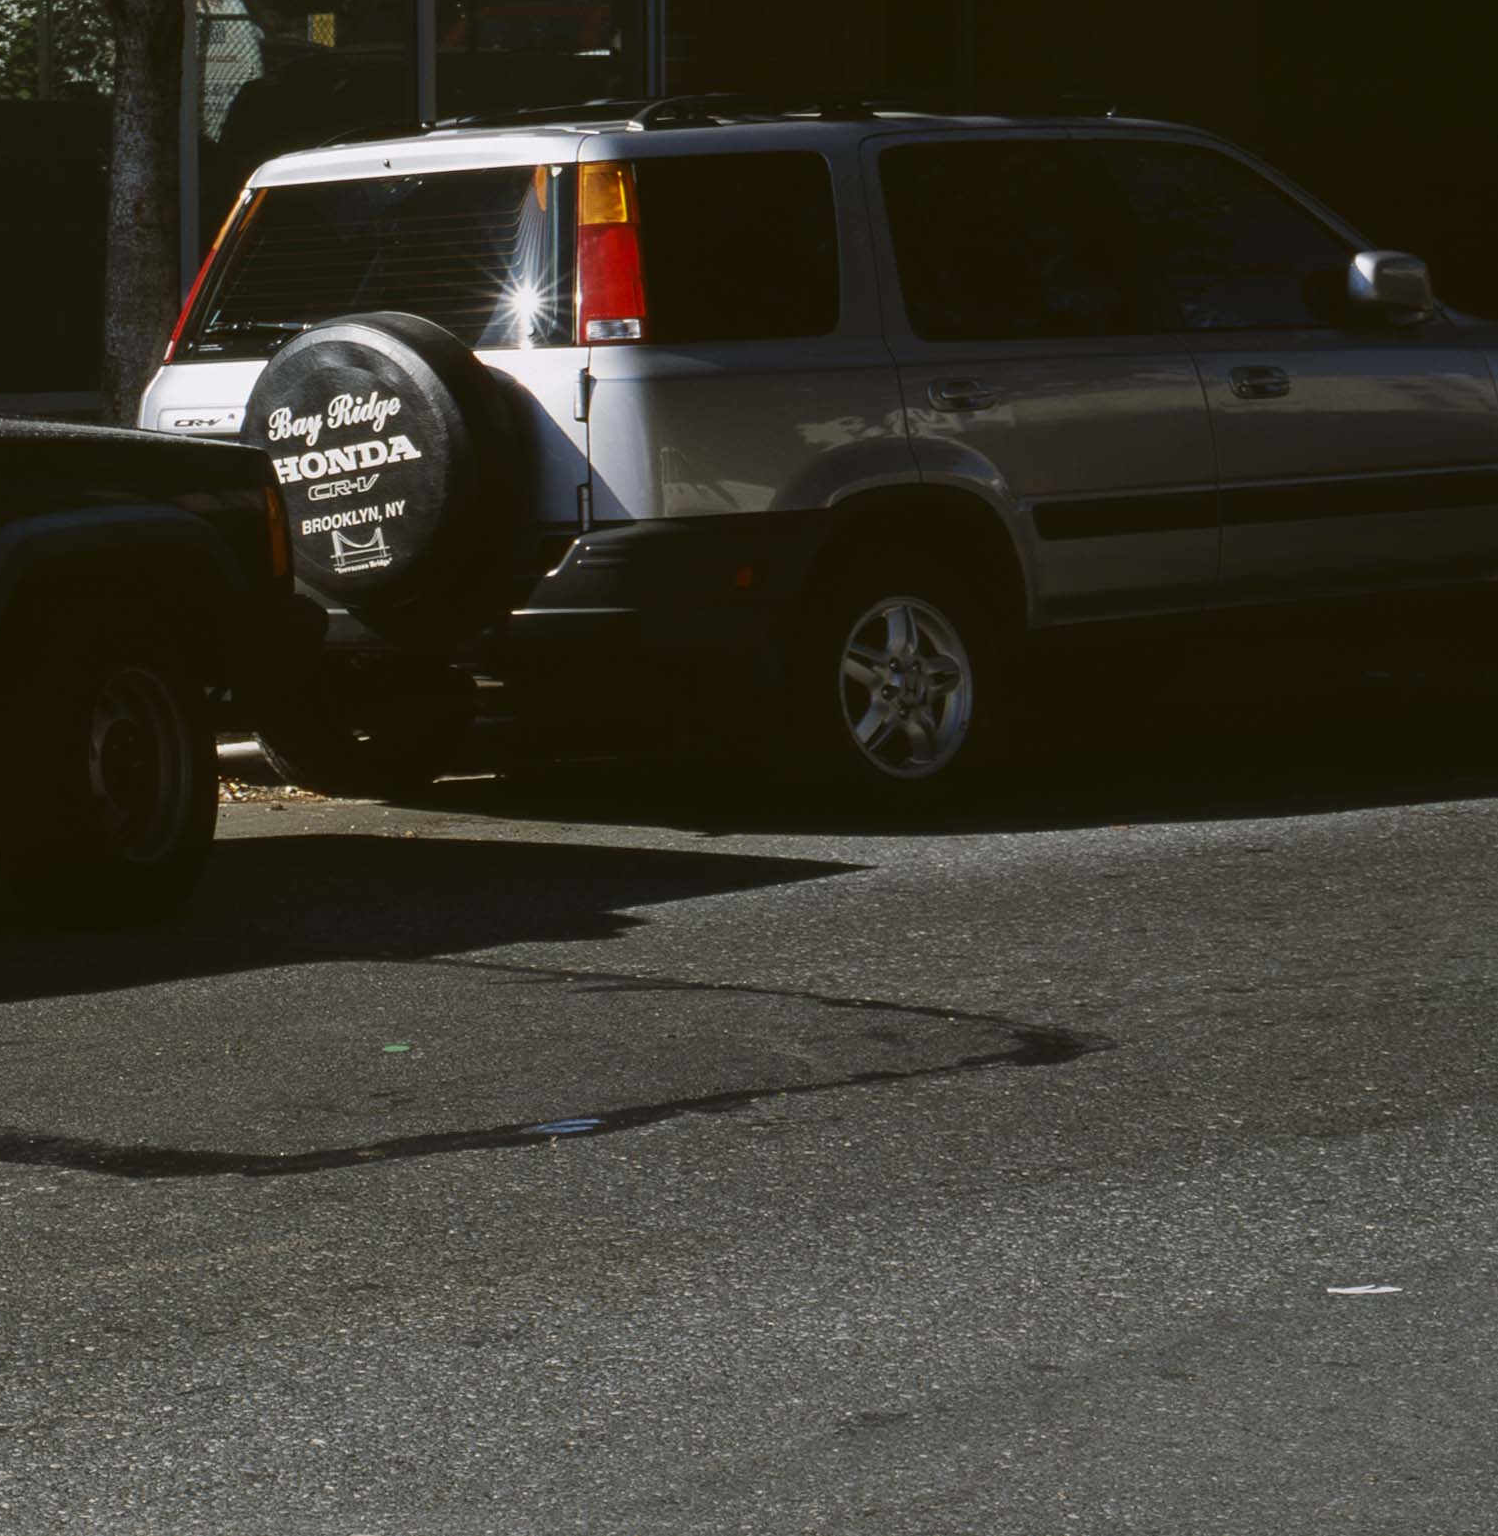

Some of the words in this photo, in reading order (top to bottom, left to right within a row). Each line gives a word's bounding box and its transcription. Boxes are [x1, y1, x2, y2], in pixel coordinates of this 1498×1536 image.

[268, 406, 322, 446] Bay
[327, 391, 401, 431] Ridge
[272, 434, 422, 484] HONDA
[308, 473, 379, 501] CR-V
[302, 505, 383, 535] BROOKLYN,
[385, 500, 406, 519] NY
